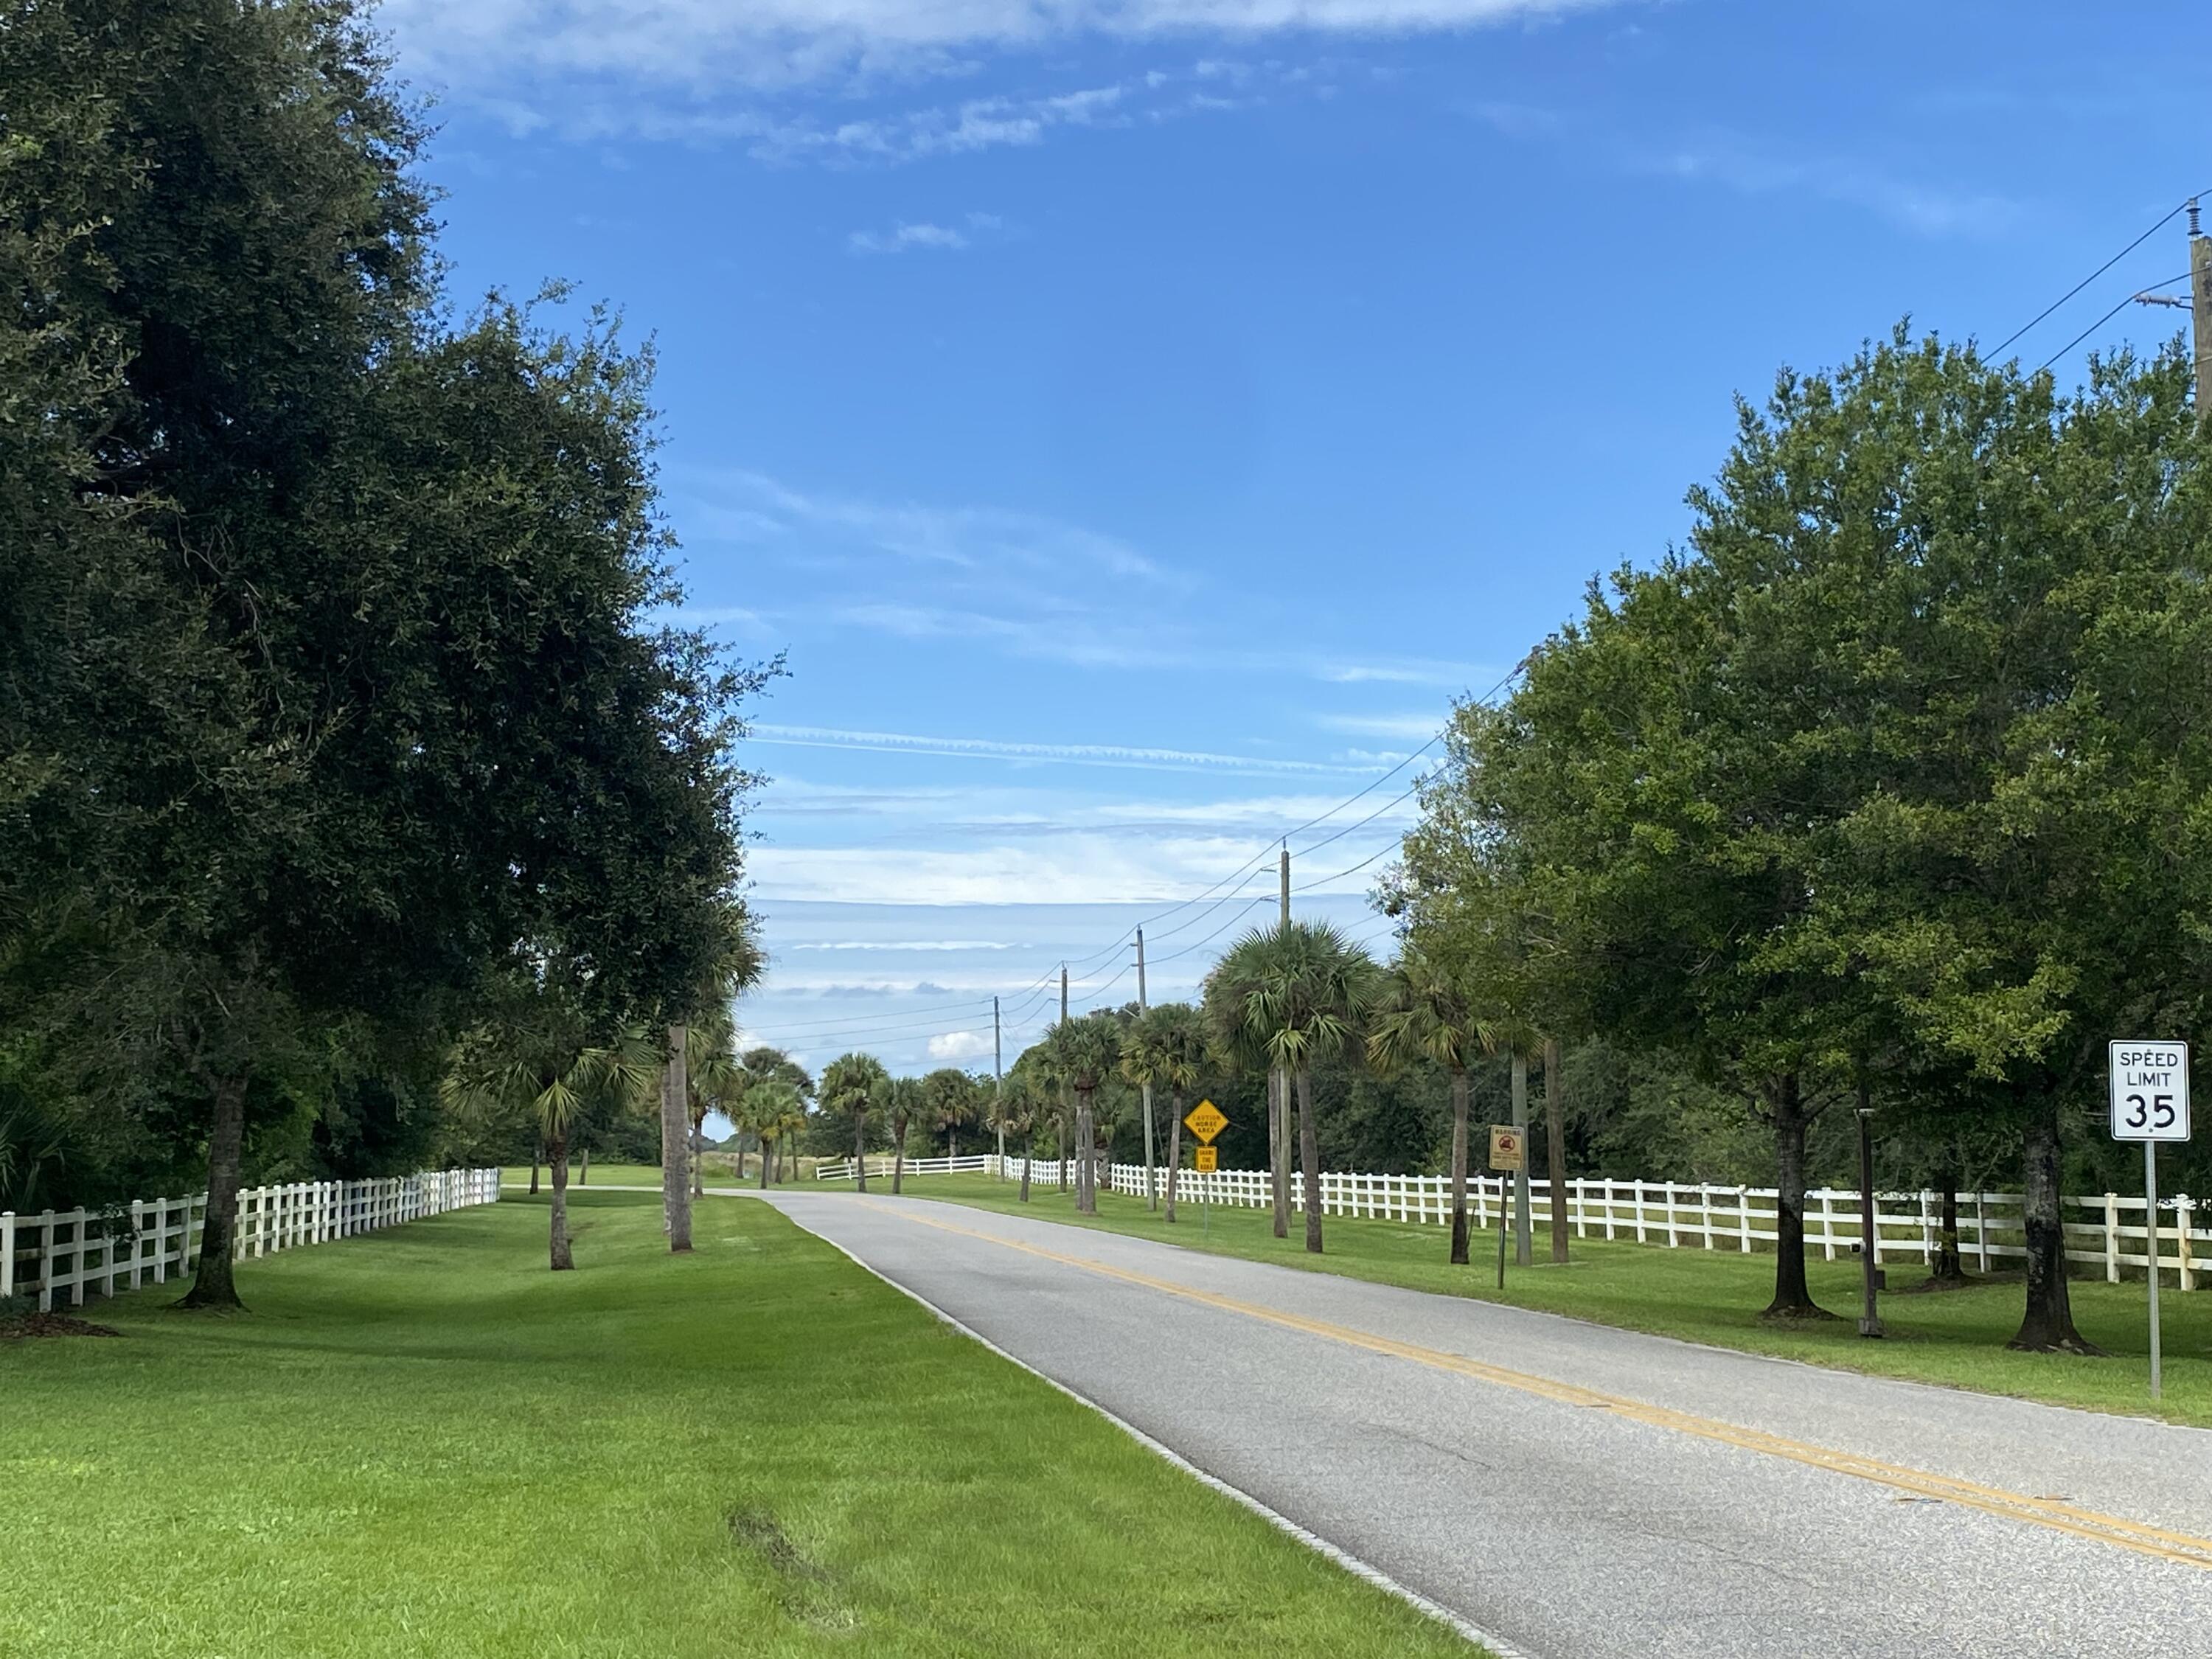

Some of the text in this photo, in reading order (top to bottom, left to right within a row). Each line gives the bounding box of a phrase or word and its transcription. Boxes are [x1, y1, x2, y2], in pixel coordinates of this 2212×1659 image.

[2120, 1052, 2178, 1067] SPEED
[2127, 1072, 2171, 1087] LIMIT
[2126, 1094, 2175, 1128] 35
